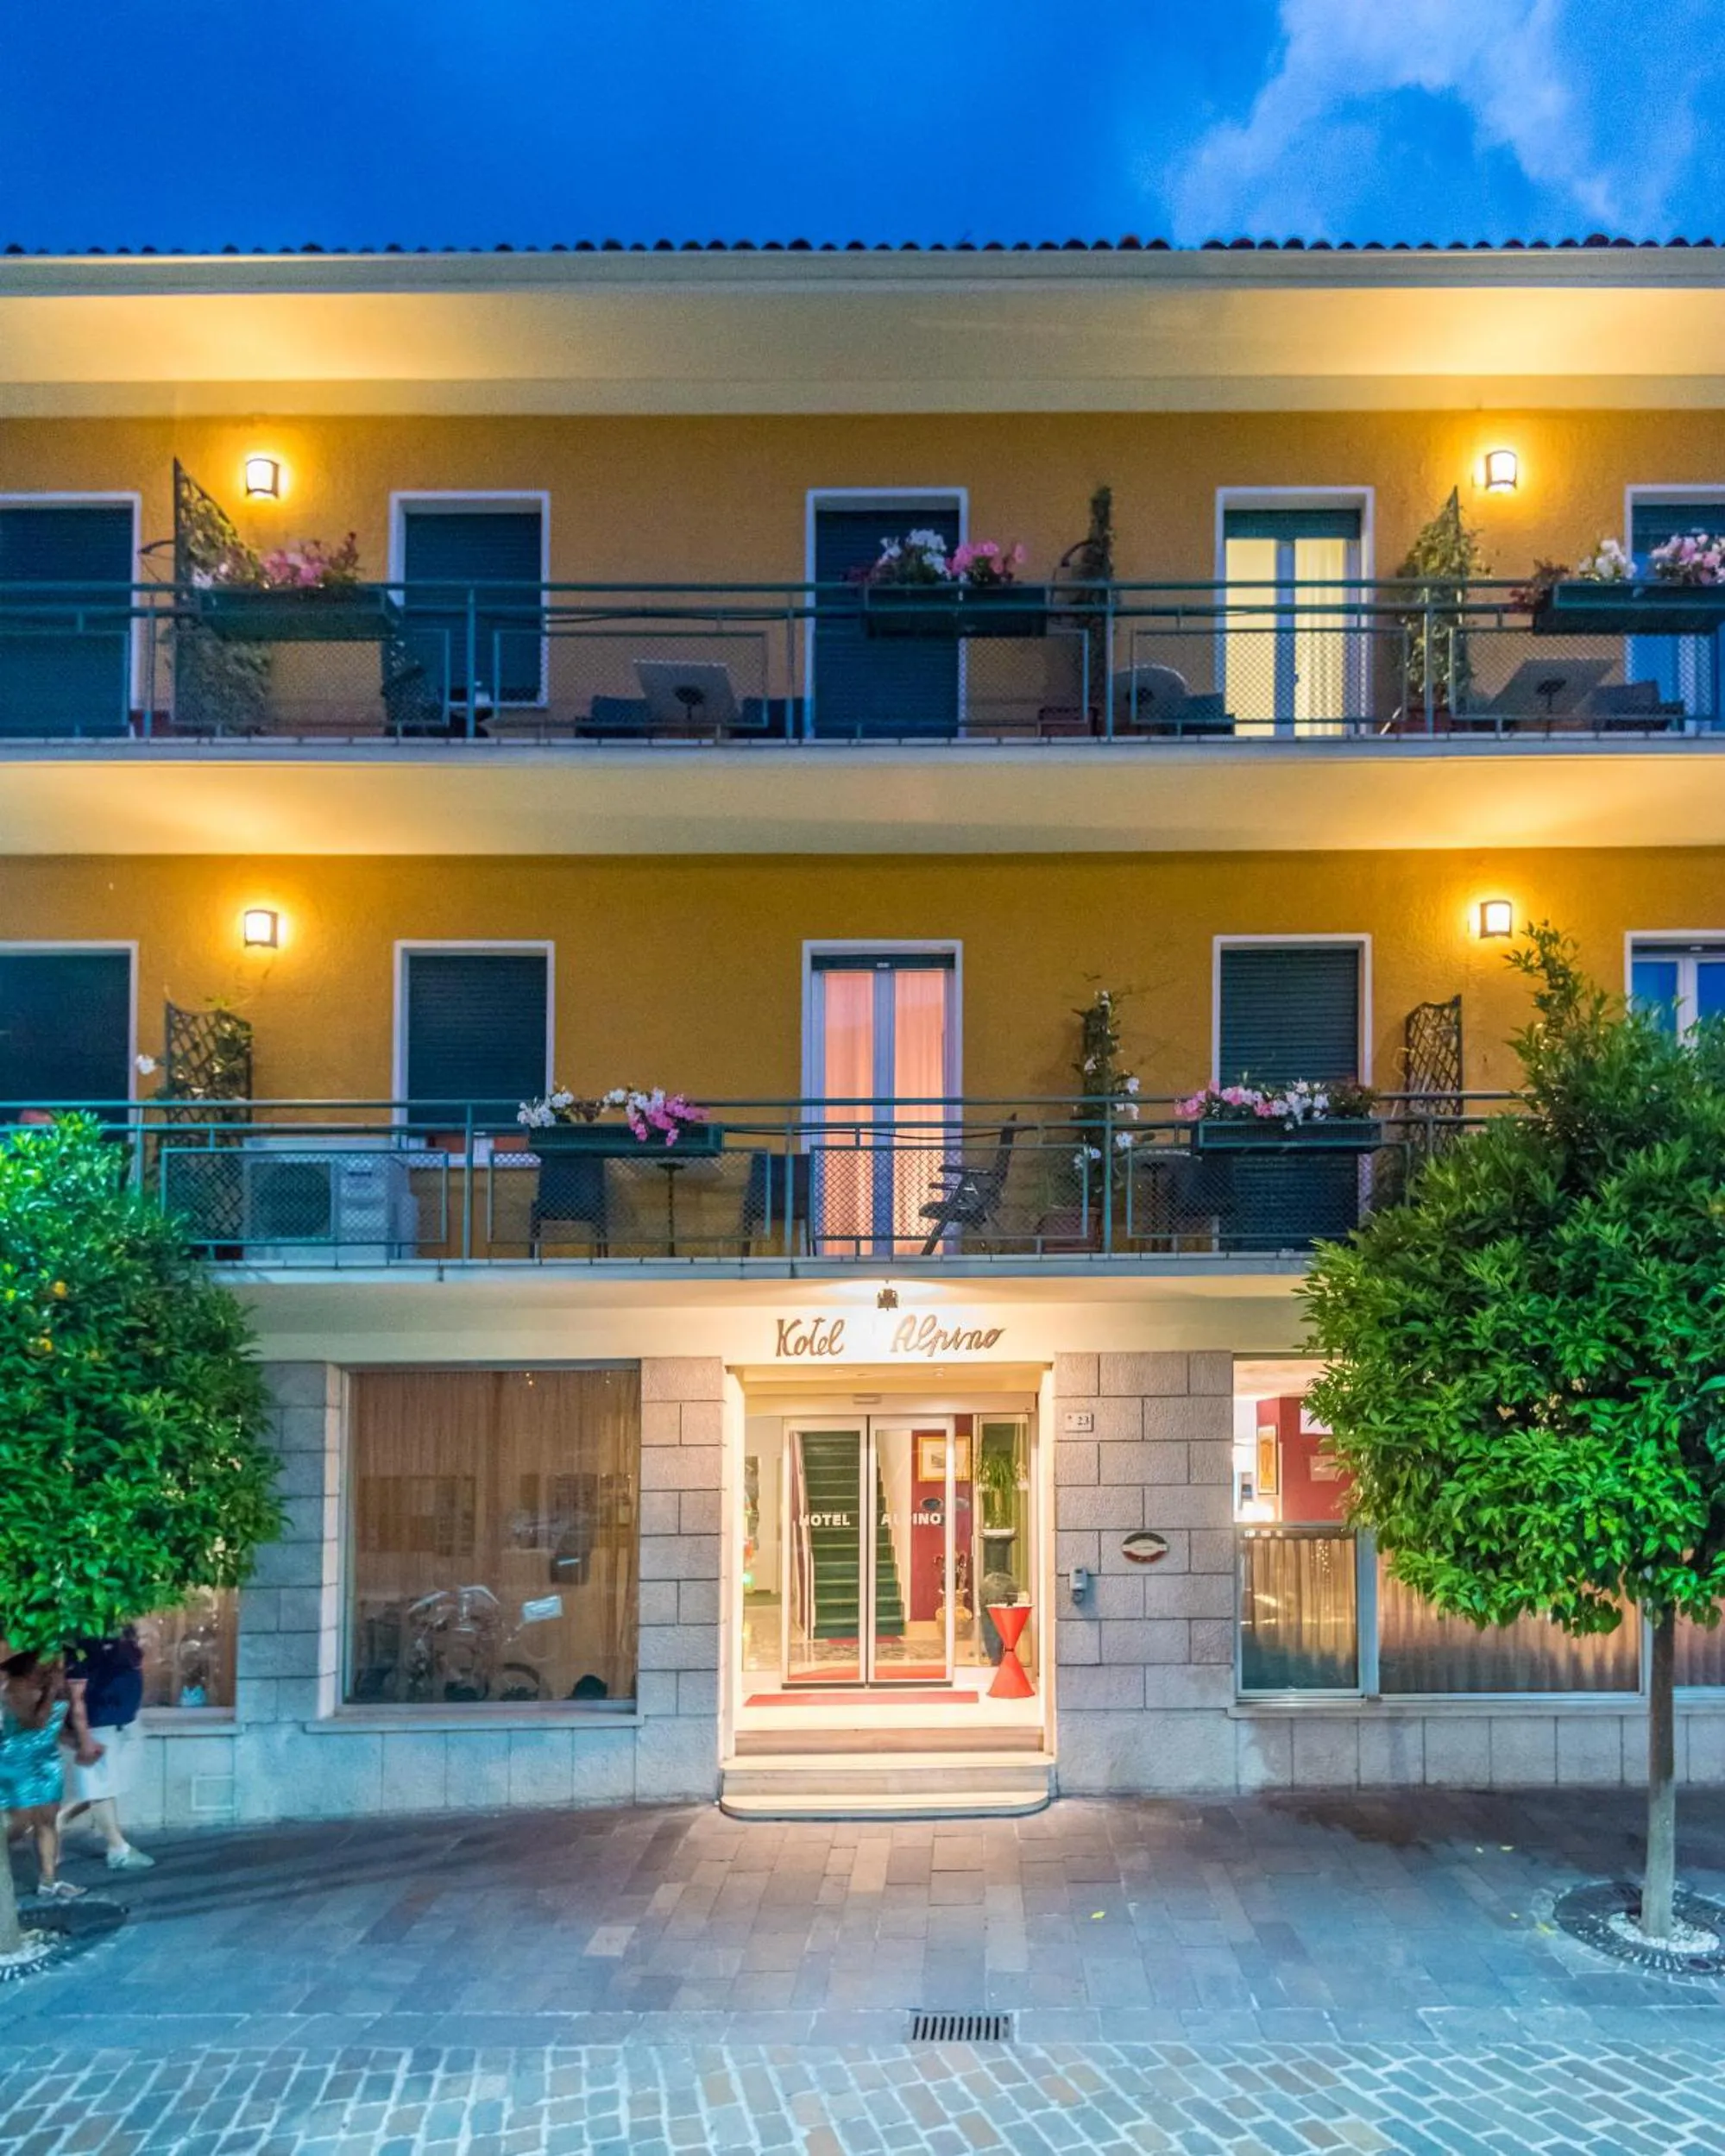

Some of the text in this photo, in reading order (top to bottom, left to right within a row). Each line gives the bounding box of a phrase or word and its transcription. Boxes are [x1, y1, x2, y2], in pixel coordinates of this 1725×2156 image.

[889, 1314, 1007, 1357] Alpino
[798, 1512, 941, 1526] HOTEL ALINO
